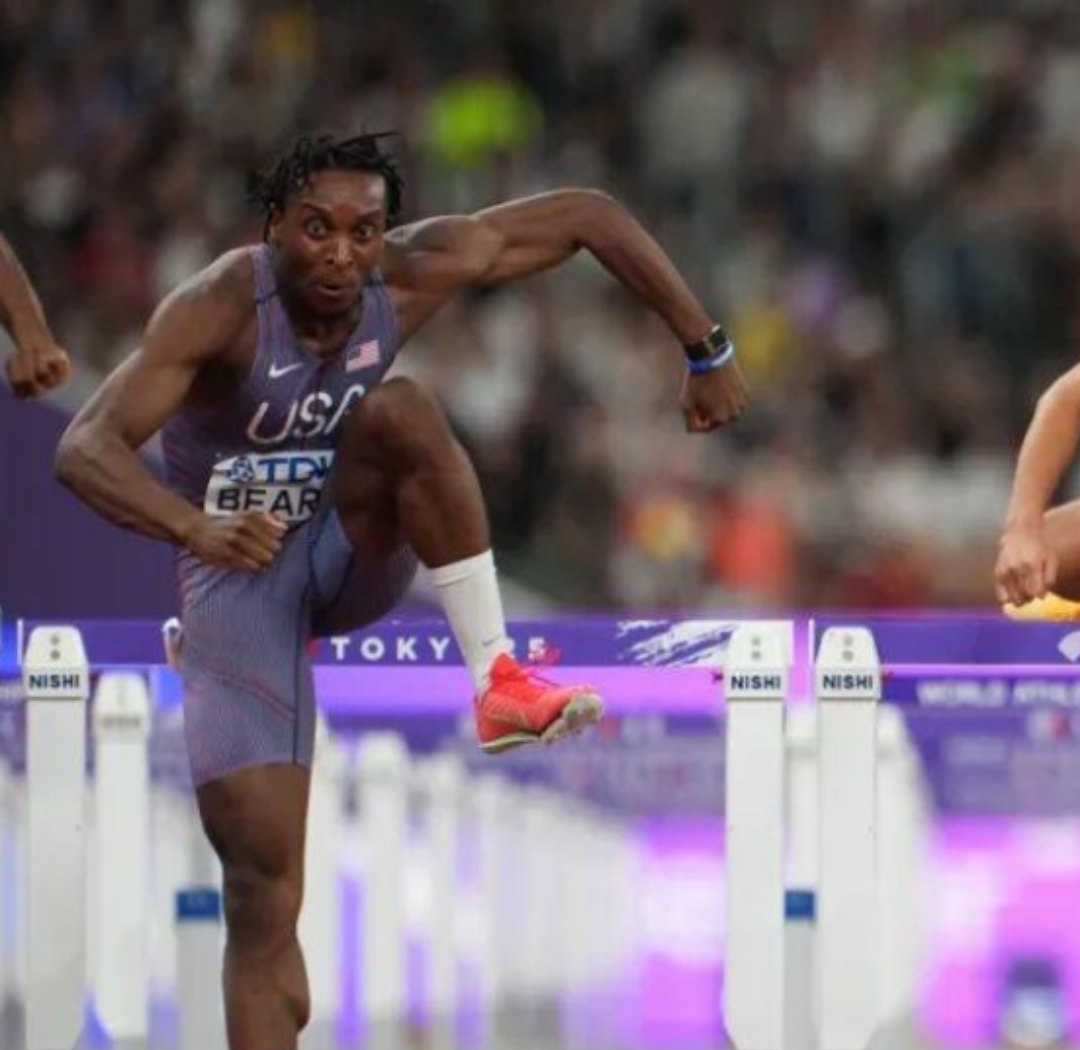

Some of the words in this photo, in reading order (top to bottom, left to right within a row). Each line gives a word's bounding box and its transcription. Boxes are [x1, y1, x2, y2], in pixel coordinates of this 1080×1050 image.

[257, 457, 327, 484] TD
[28, 674, 80, 689] NISHI
[731, 675, 782, 690] NISHI
[822, 675, 874, 690] NISHI
